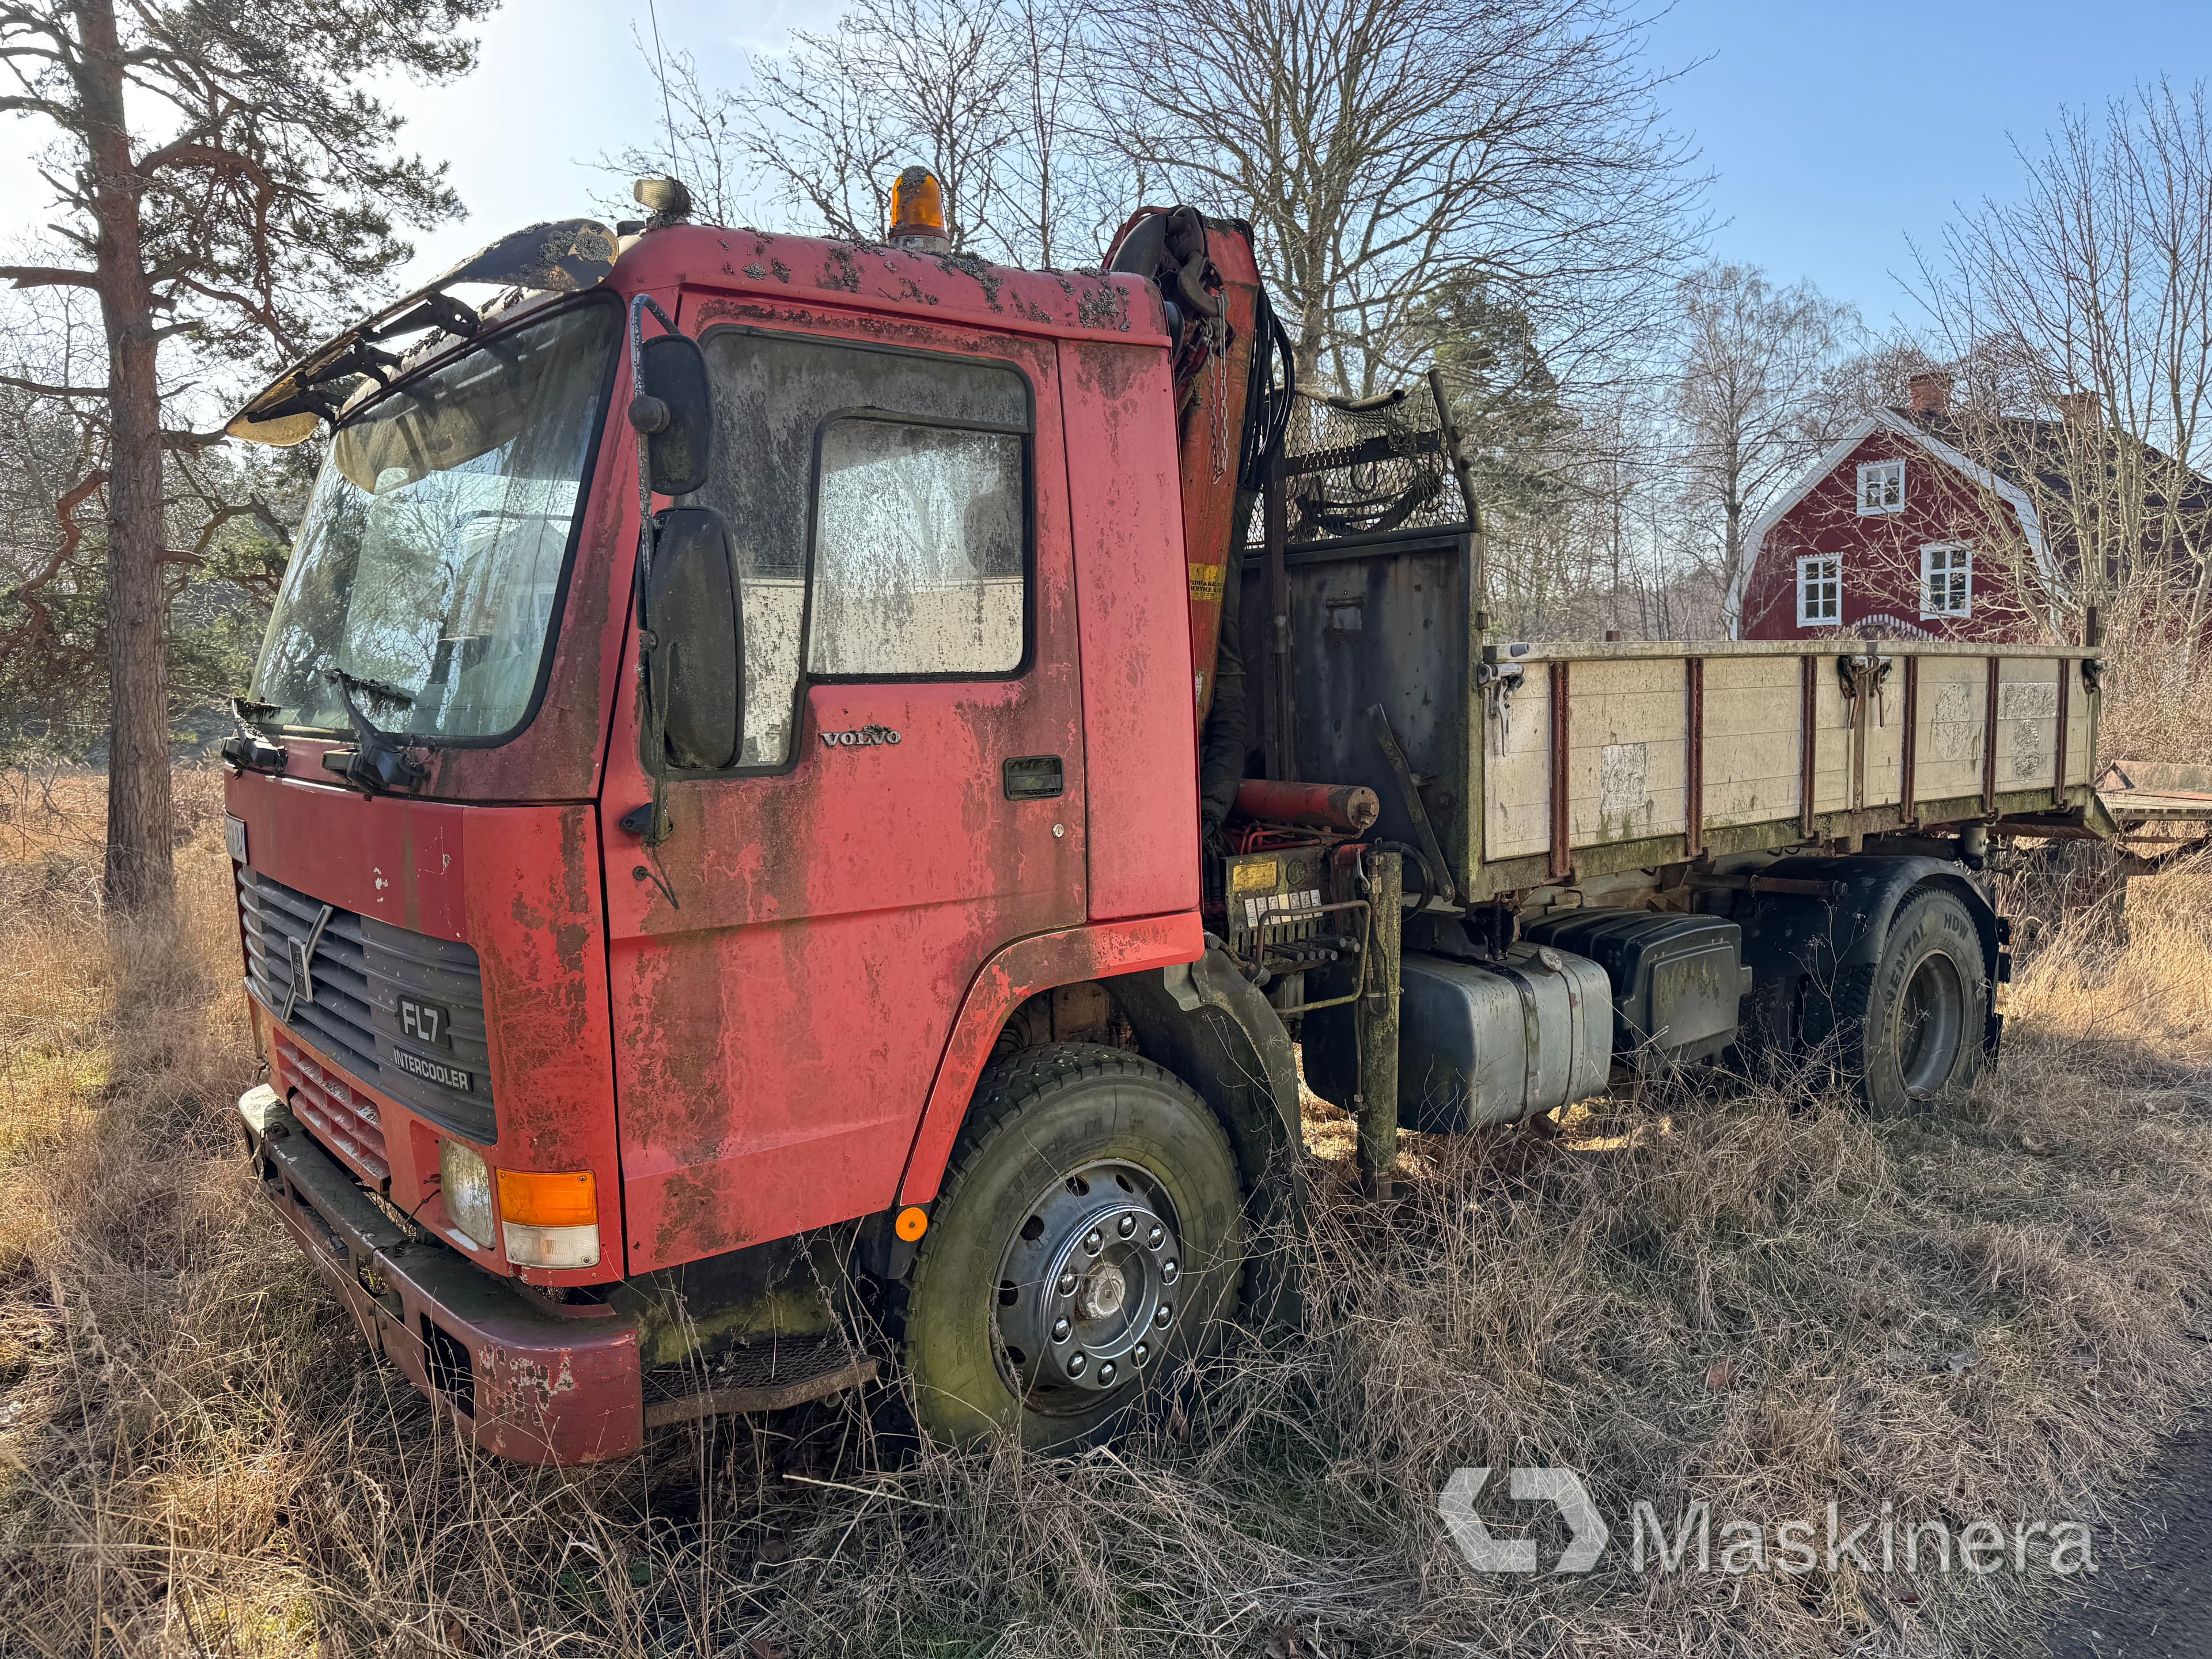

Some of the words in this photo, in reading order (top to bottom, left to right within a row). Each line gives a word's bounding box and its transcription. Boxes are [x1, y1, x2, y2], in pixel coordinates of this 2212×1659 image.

[820, 730, 903, 747] VOLVO
[402, 1001, 438, 1043] FL7
[1880, 922, 1927, 1094] COTINENTAL
[1944, 912, 1969, 941] HDW
[393, 1048, 469, 1090] INTERCOOLER
